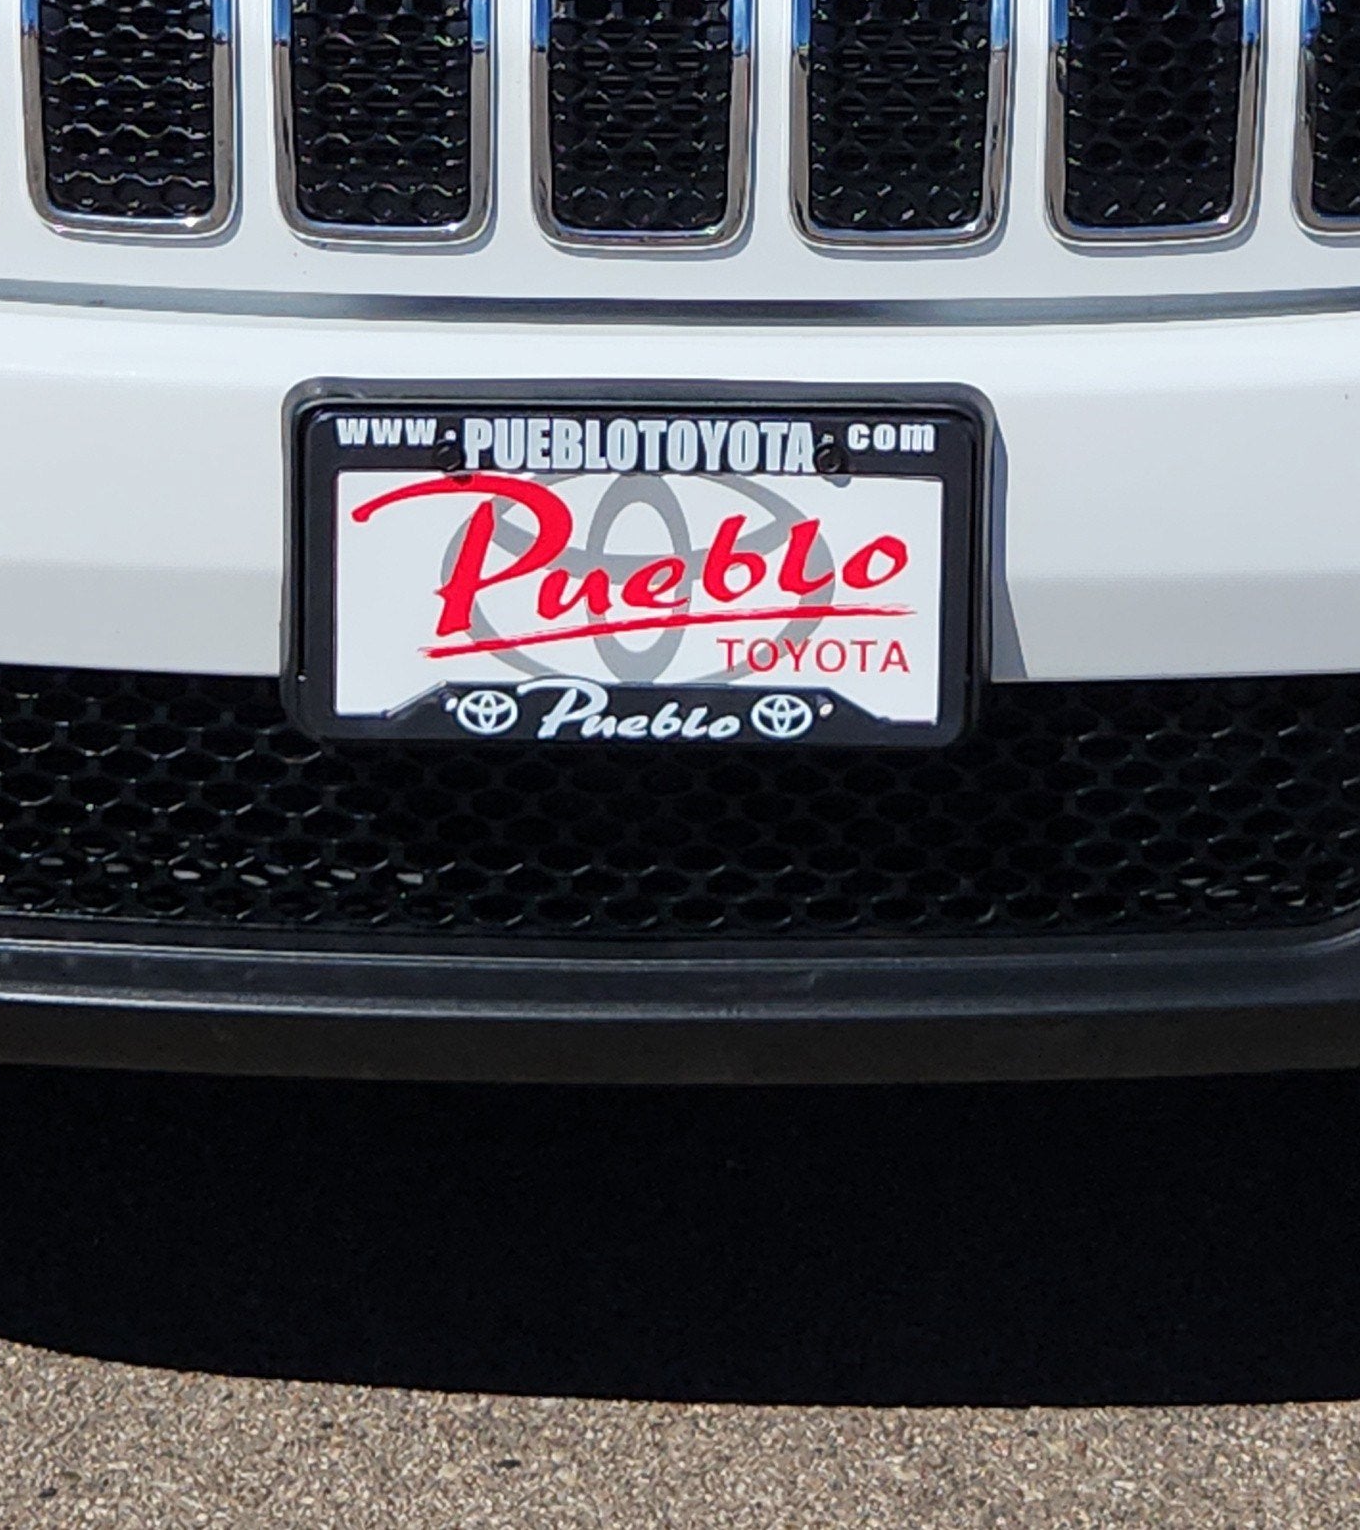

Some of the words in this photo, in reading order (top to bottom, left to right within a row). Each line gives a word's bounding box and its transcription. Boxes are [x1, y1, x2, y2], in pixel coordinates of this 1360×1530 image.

[351, 472, 909, 637] Pueblo
[716, 637, 911, 675] TOYOTA
[516, 678, 741, 741] Pueblo
